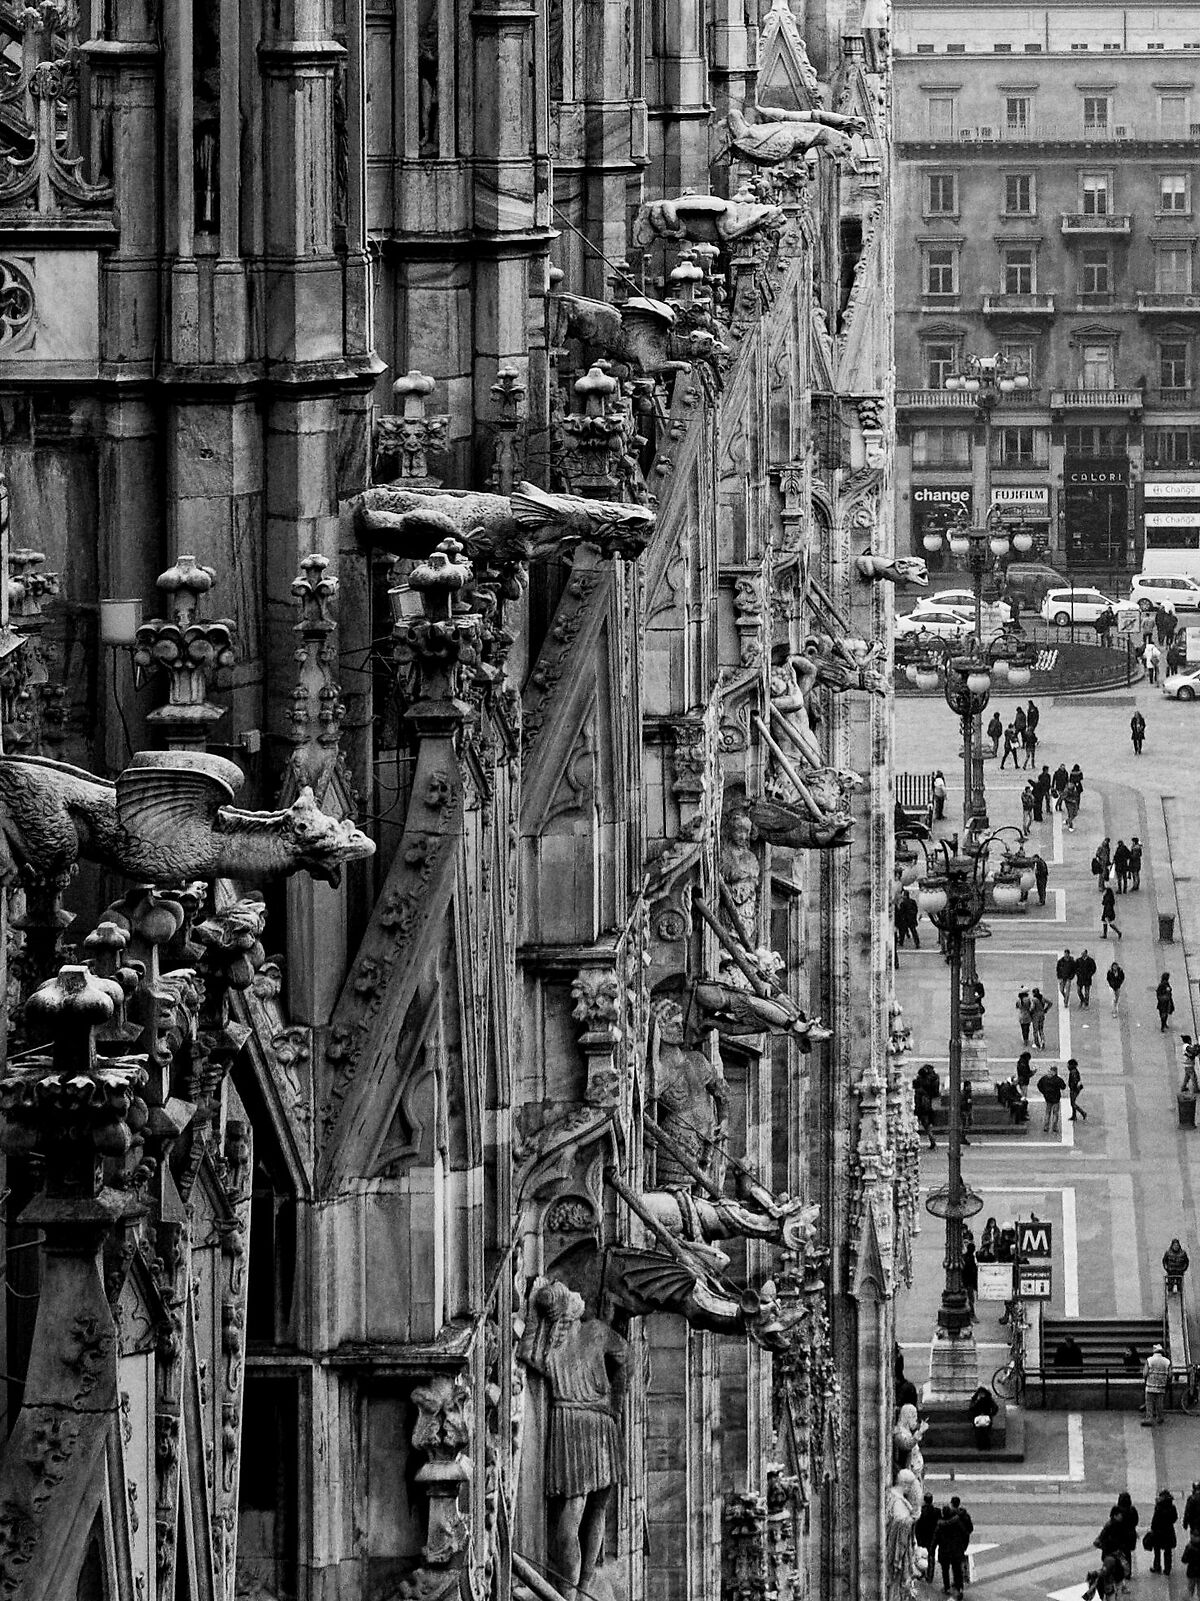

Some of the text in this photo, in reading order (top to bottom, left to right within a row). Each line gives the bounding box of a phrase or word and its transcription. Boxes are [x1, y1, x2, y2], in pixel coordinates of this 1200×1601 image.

[1071, 473, 1122, 481] CALORI
[1165, 484, 1196, 495] Change
[914, 488, 970, 503] change
[995, 490, 1044, 500] FUJIFILM
[1165, 515, 1196, 525] Change
[1022, 1229, 1049, 1251] M
